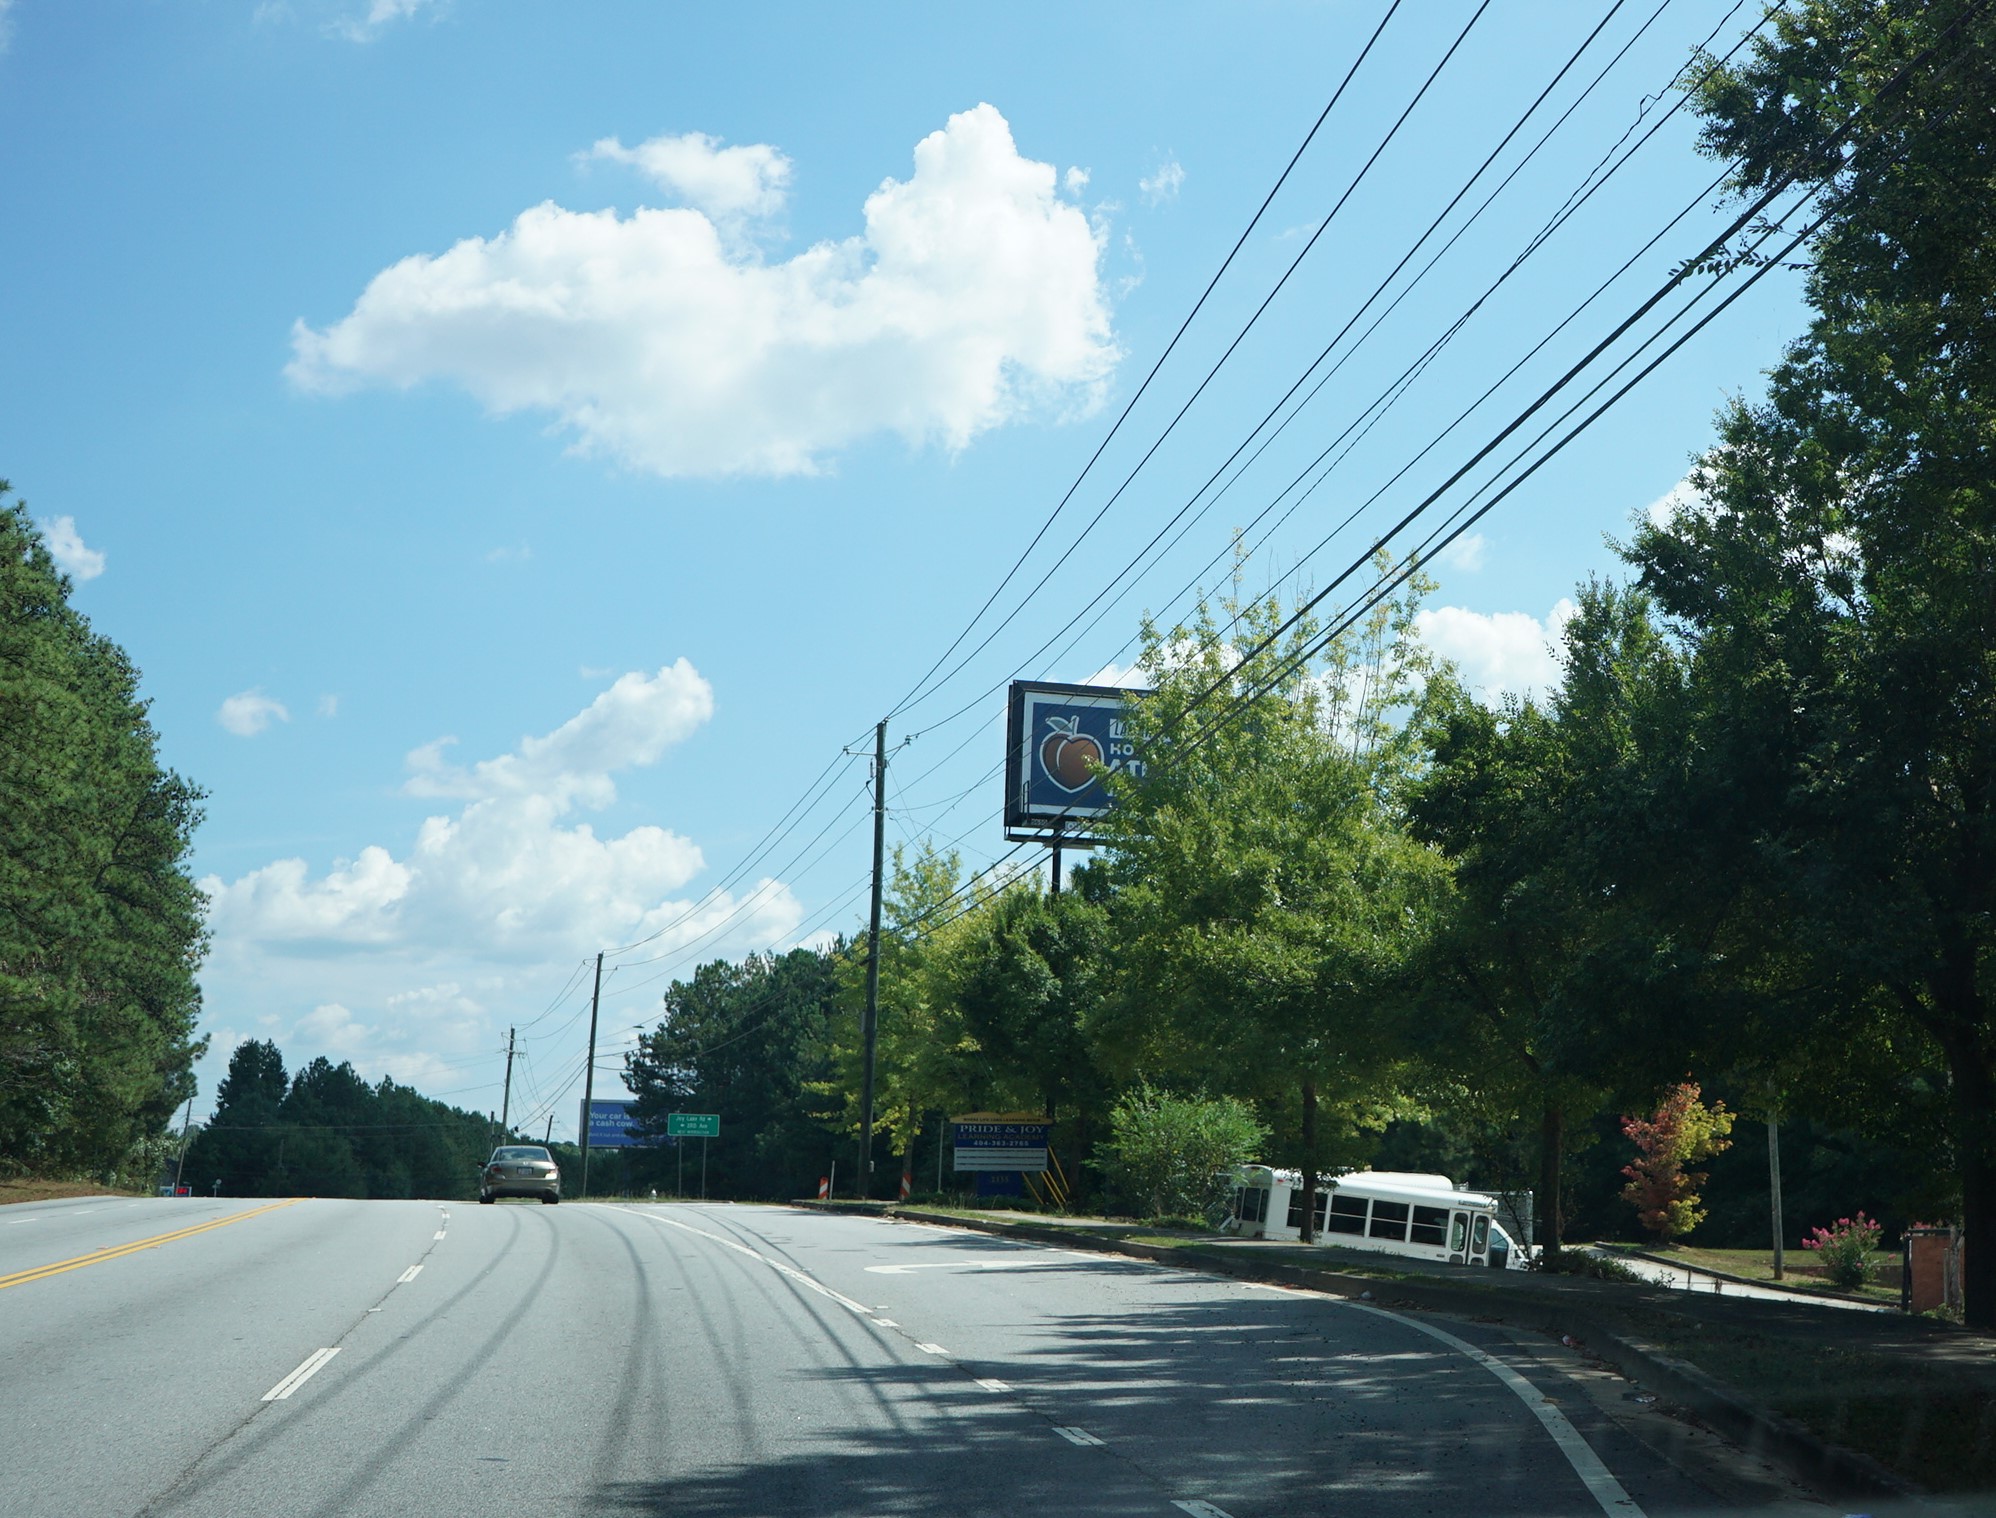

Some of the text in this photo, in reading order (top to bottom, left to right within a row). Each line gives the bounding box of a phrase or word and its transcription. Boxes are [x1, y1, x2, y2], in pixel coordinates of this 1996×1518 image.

[589, 1111, 608, 1120] Your
[596, 1119, 615, 1127] cash
[960, 1125, 1044, 1133] PRIDE & JOY
